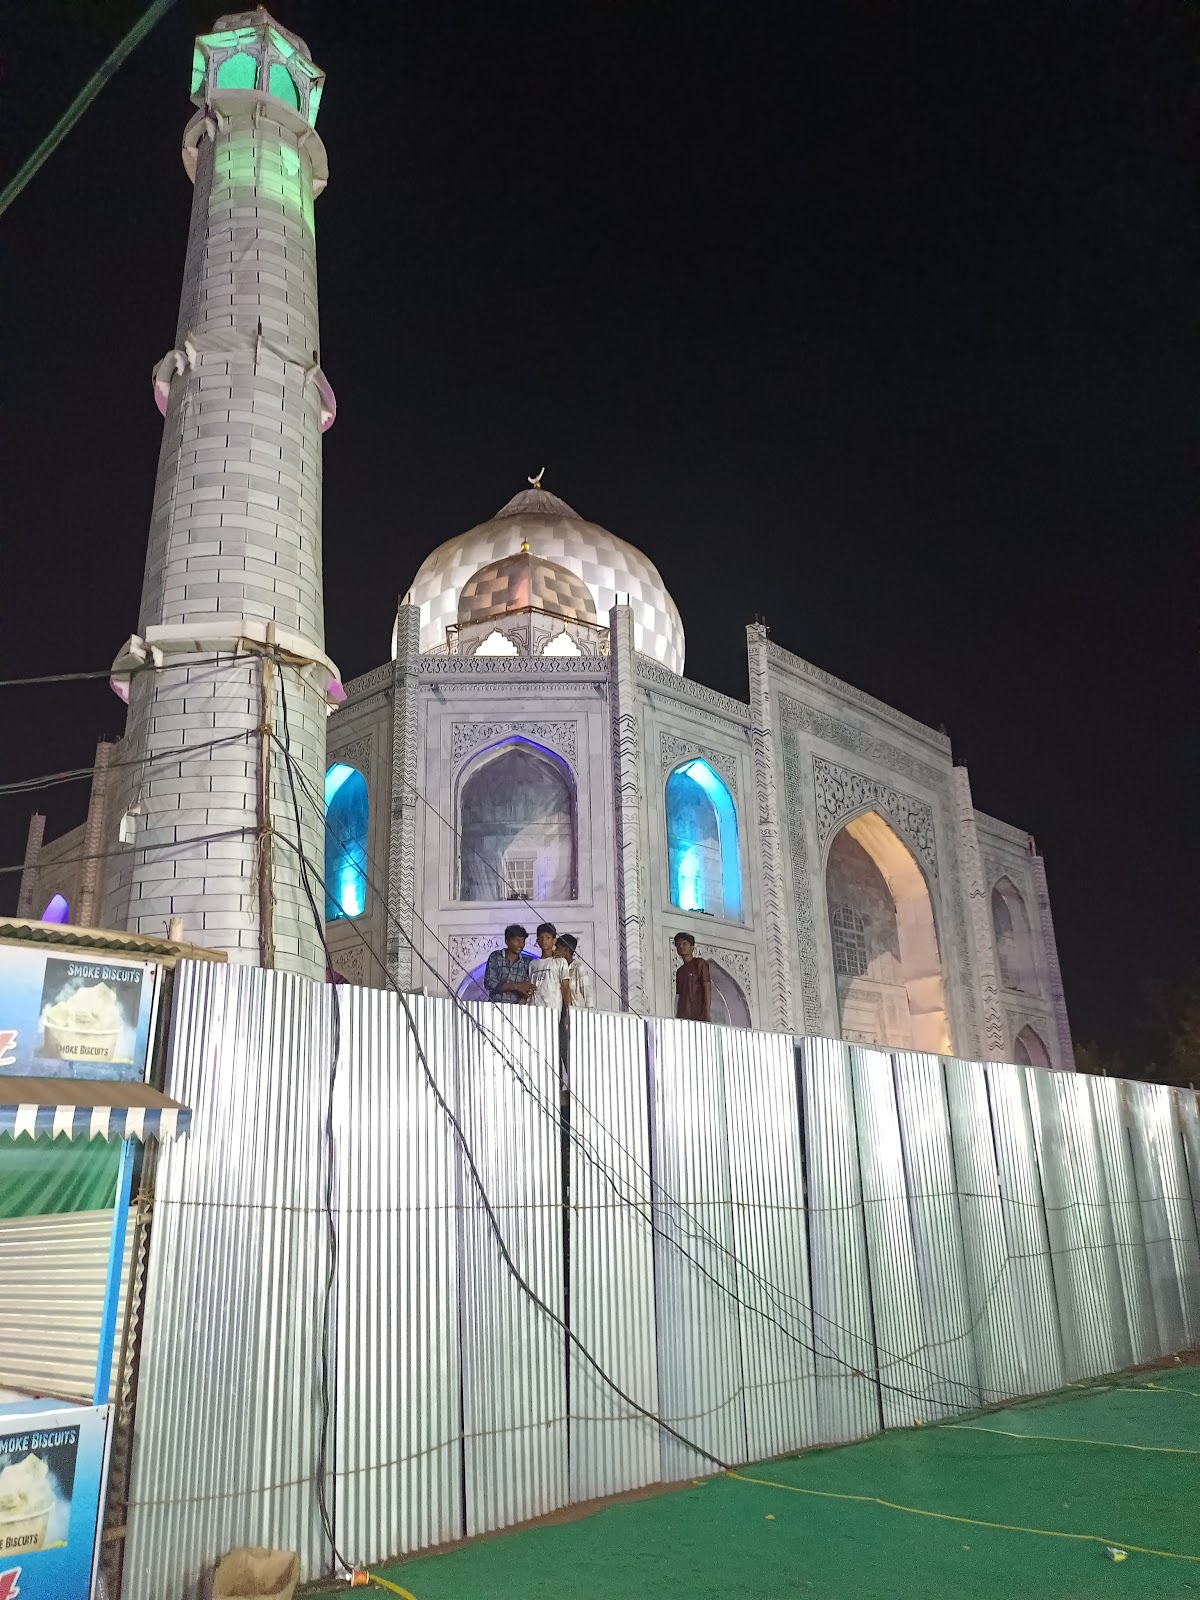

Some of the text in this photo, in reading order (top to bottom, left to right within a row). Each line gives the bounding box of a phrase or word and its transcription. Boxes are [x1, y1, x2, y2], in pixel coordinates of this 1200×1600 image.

[67, 963, 140, 983] SMOKE BISCUITS
[80, 1045, 109, 1056] BISCUITS
[31, 1430, 76, 1449] BISCUITS
[5, 1533, 38, 1549] BISCUITS
